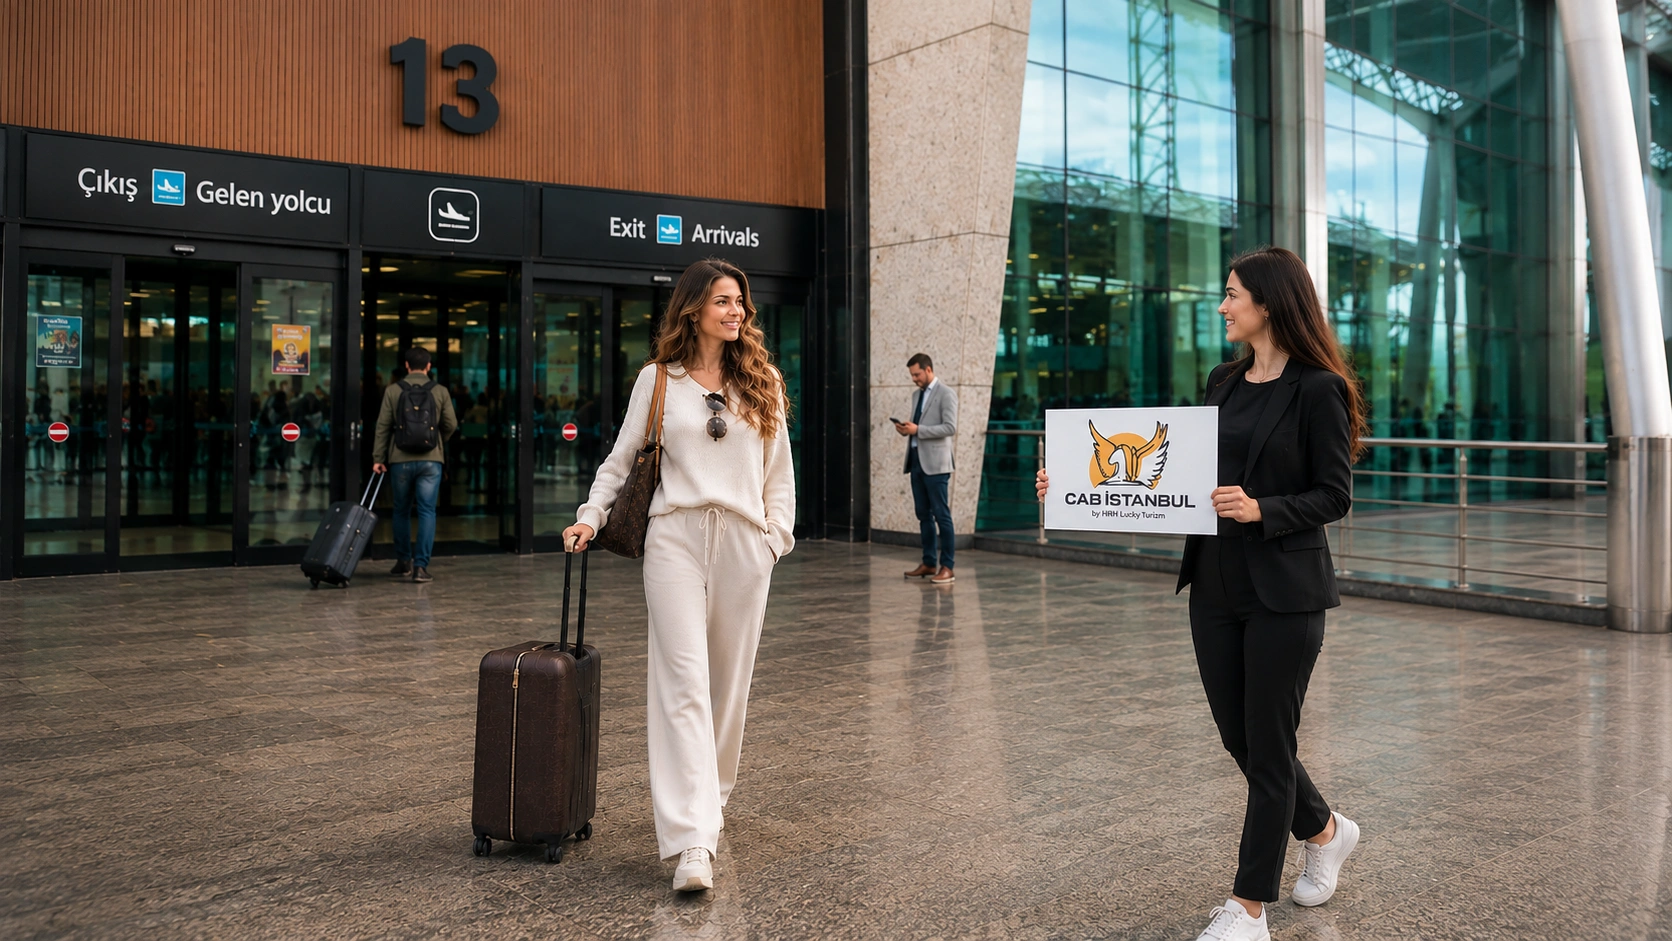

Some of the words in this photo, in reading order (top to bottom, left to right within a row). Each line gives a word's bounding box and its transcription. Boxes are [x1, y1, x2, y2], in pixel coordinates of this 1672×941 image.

[388, 36, 500, 136] 13
[77, 167, 138, 203] Çıkış
[196, 180, 264, 209] Gelen
[270, 188, 331, 216] yolcu
[609, 216, 646, 240] Exit
[691, 223, 760, 248] Arrivals
[1065, 492, 1102, 506] CAB
[1105, 490, 1196, 508] İSTANBUL
[1091, 509, 1101, 519] by
[1120, 510, 1141, 520] Lucky
[1142, 511, 1166, 520] Turizm
